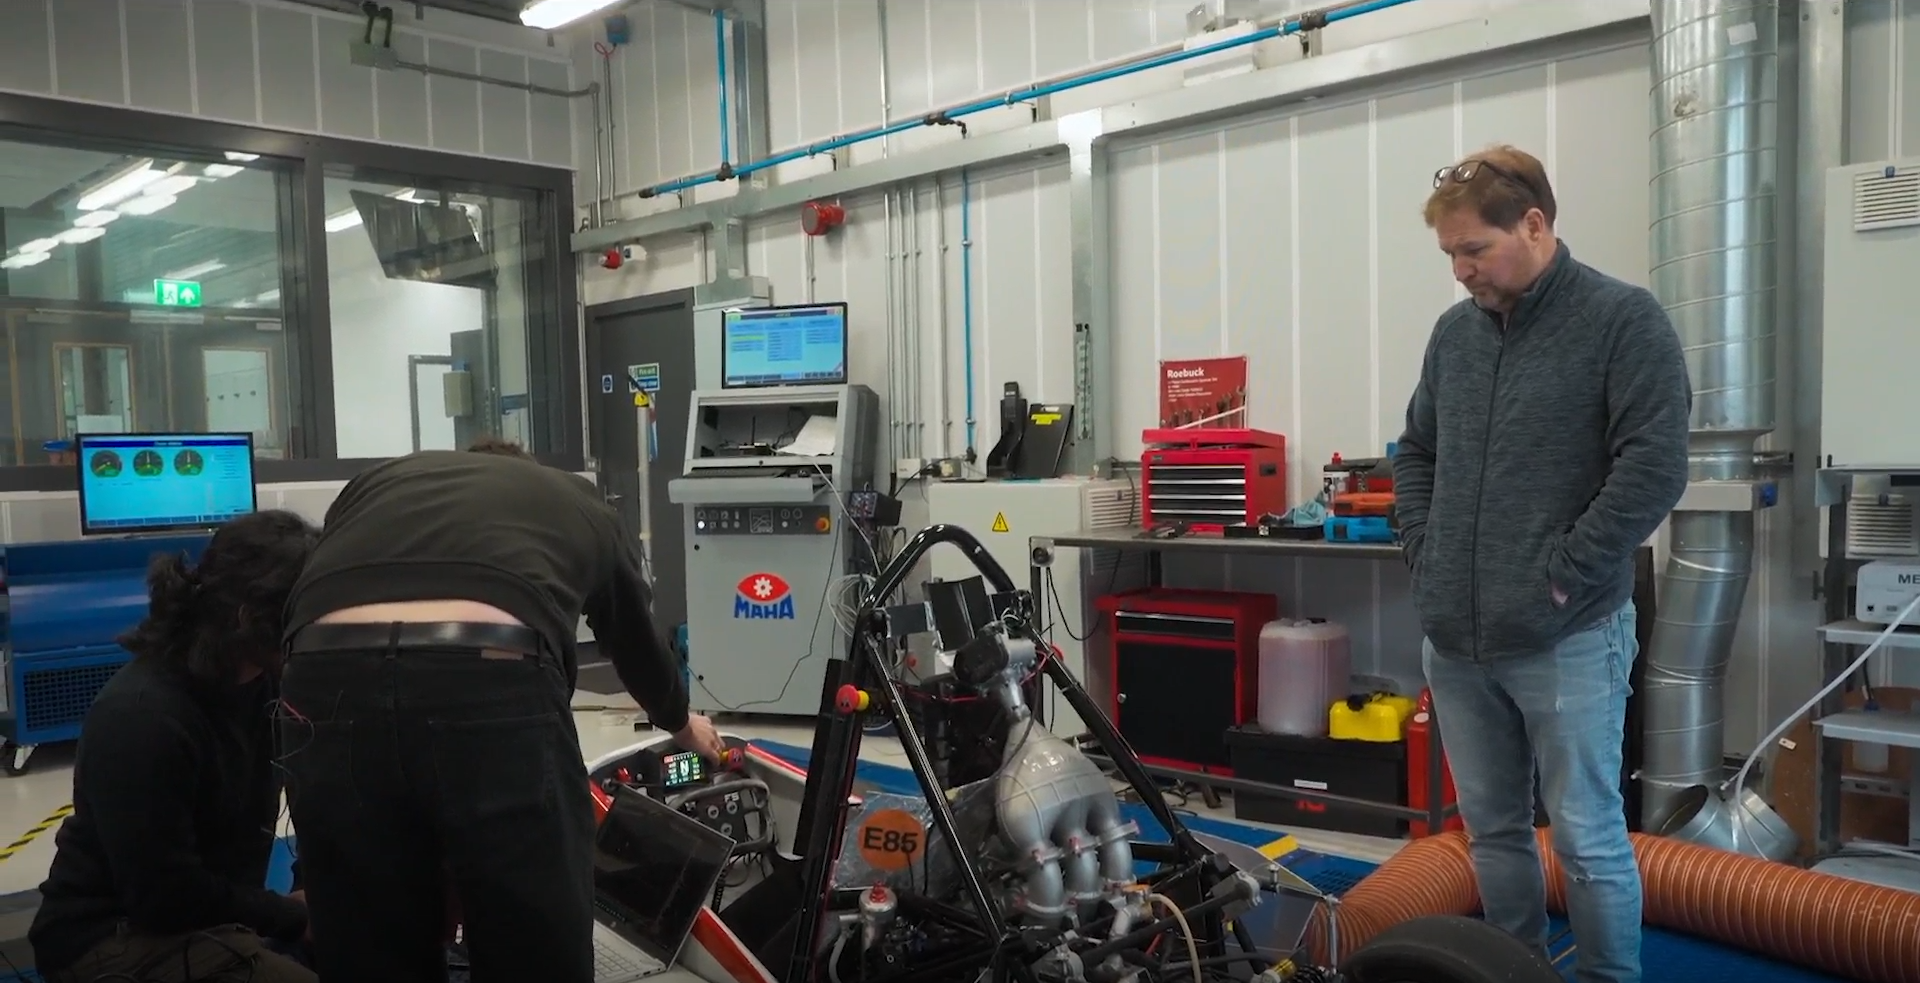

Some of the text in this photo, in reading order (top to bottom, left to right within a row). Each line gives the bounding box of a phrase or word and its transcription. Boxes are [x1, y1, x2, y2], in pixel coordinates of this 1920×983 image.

[1167, 367, 1205, 379] Roebuck
[734, 592, 795, 620] MAHA
[864, 826, 918, 853] E85
